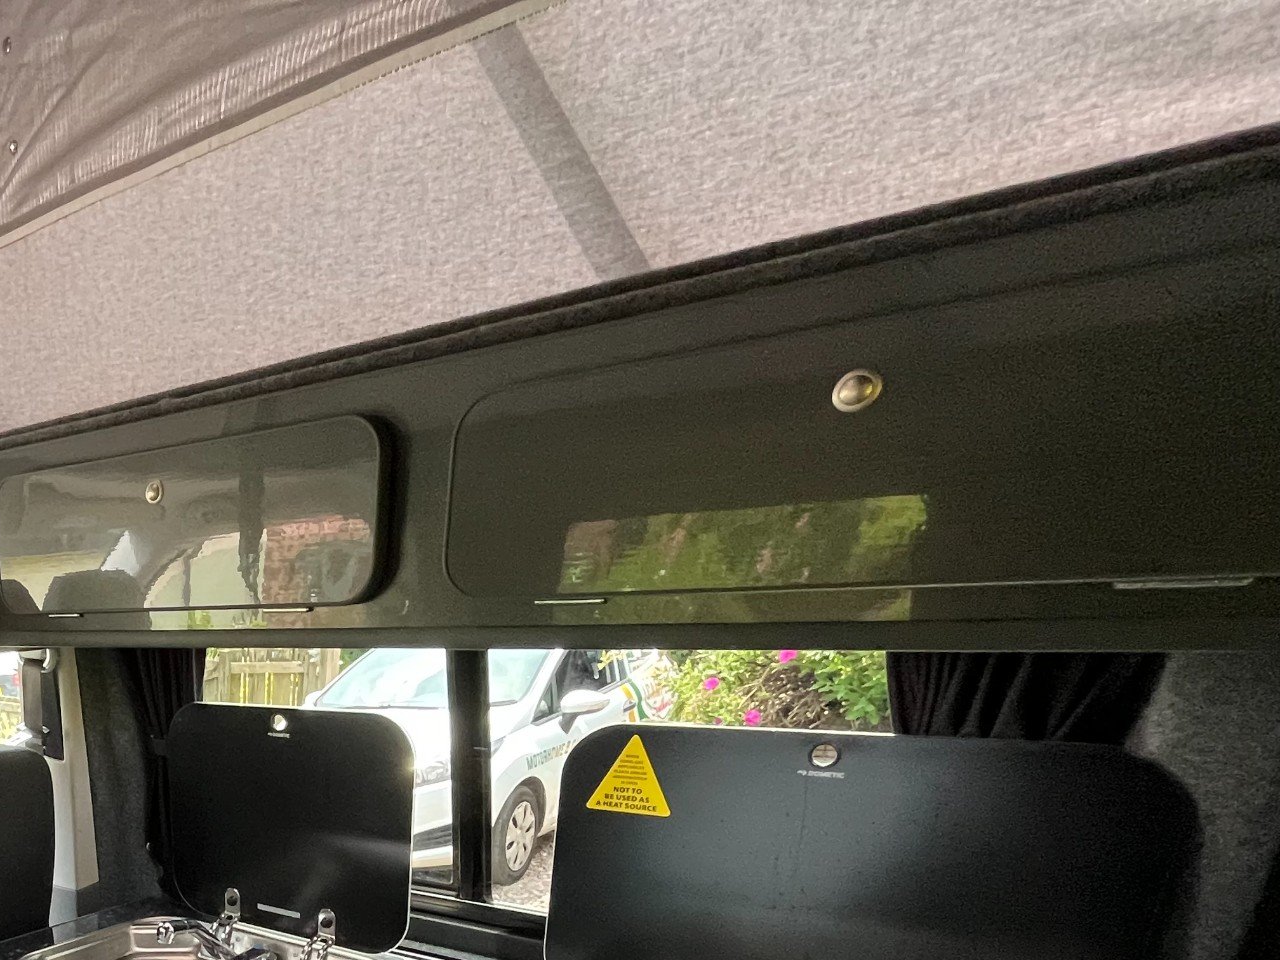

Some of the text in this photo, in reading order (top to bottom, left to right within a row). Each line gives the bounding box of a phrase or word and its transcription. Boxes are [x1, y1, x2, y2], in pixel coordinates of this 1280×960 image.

[632, 787, 643, 795] TO
[616, 794, 638, 802] USED
[638, 796, 650, 804] AS
[603, 800, 623, 808] HEAT
[624, 802, 657, 812] SOURCE
